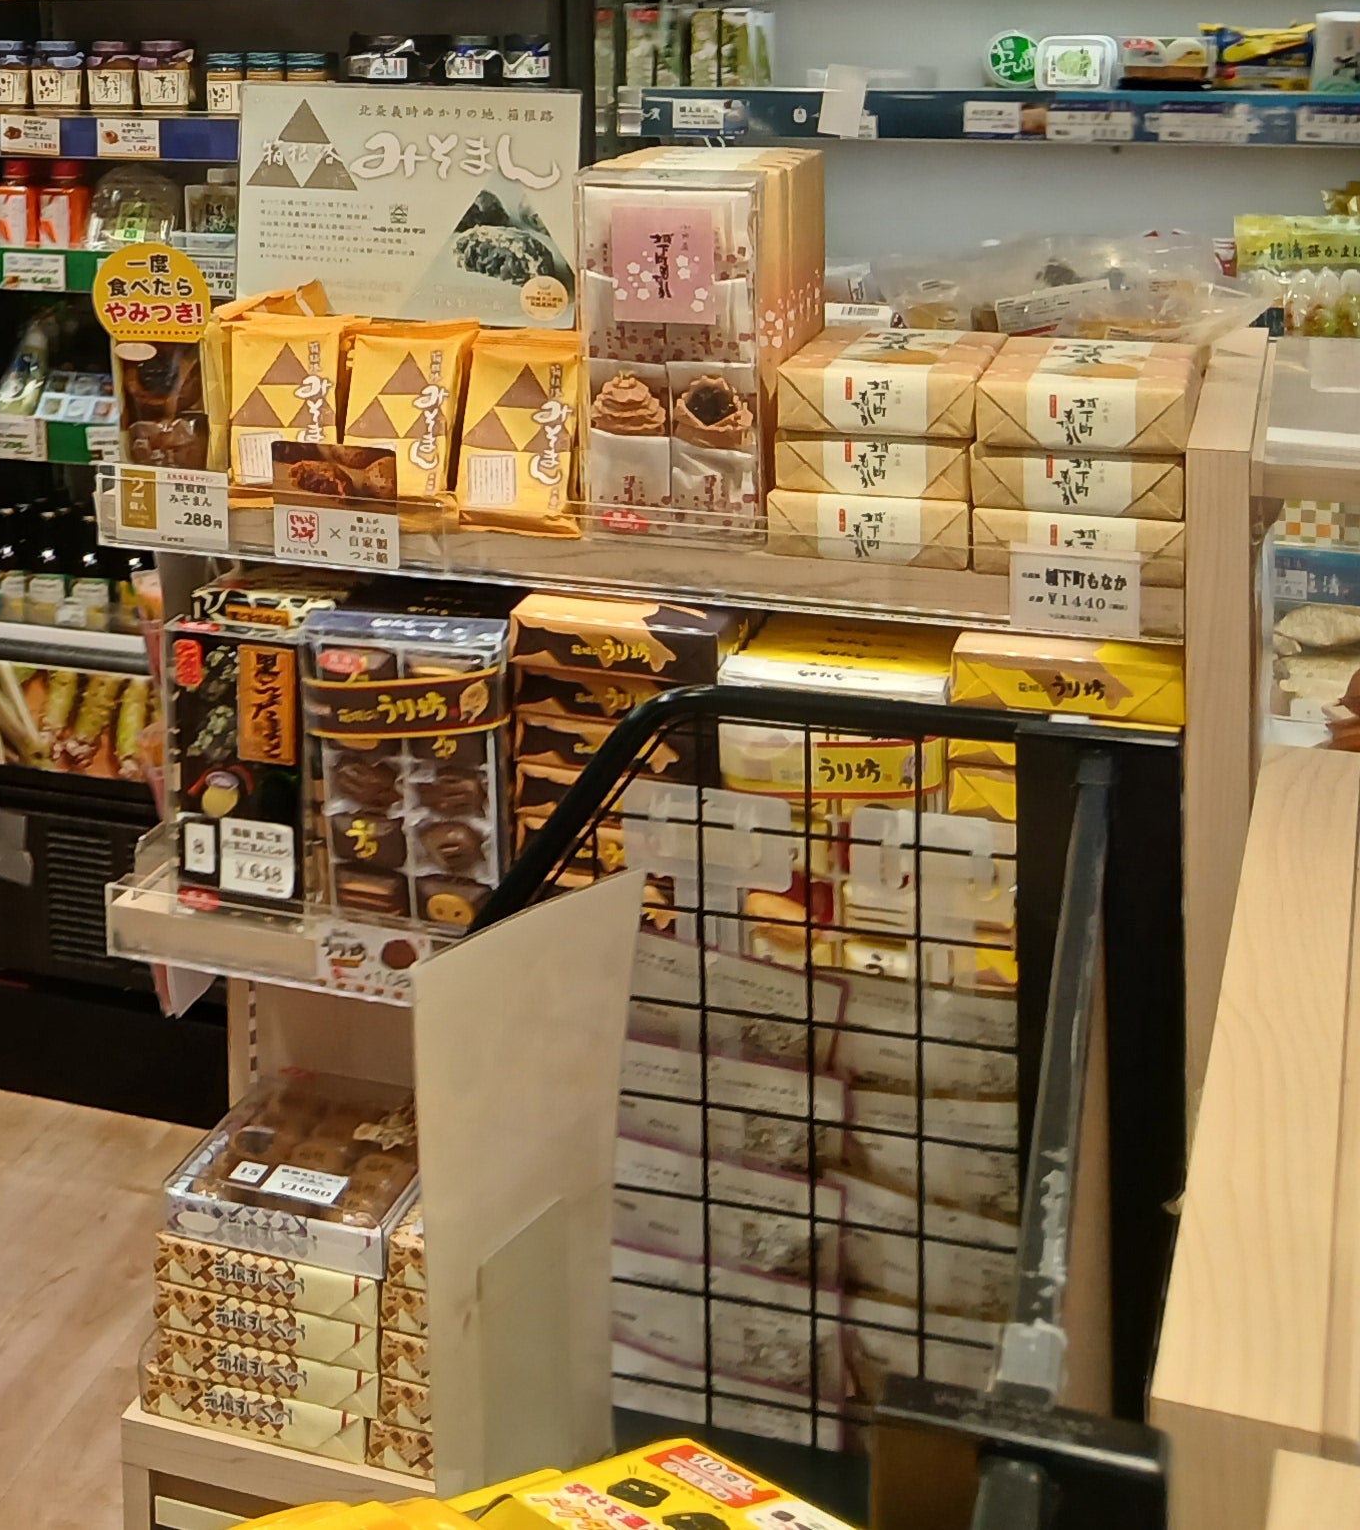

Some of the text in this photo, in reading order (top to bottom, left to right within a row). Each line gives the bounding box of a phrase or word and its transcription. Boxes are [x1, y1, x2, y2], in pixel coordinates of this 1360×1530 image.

[349, 130, 561, 190] みそまん
[127, 254, 170, 274] 一度
[108, 278, 193, 297] 食べたら
[104, 302, 203, 324] やみつき!
[294, 374, 332, 443] みそま
[169, 494, 212, 507] みそまん
[818, 757, 881, 782] うり坊
